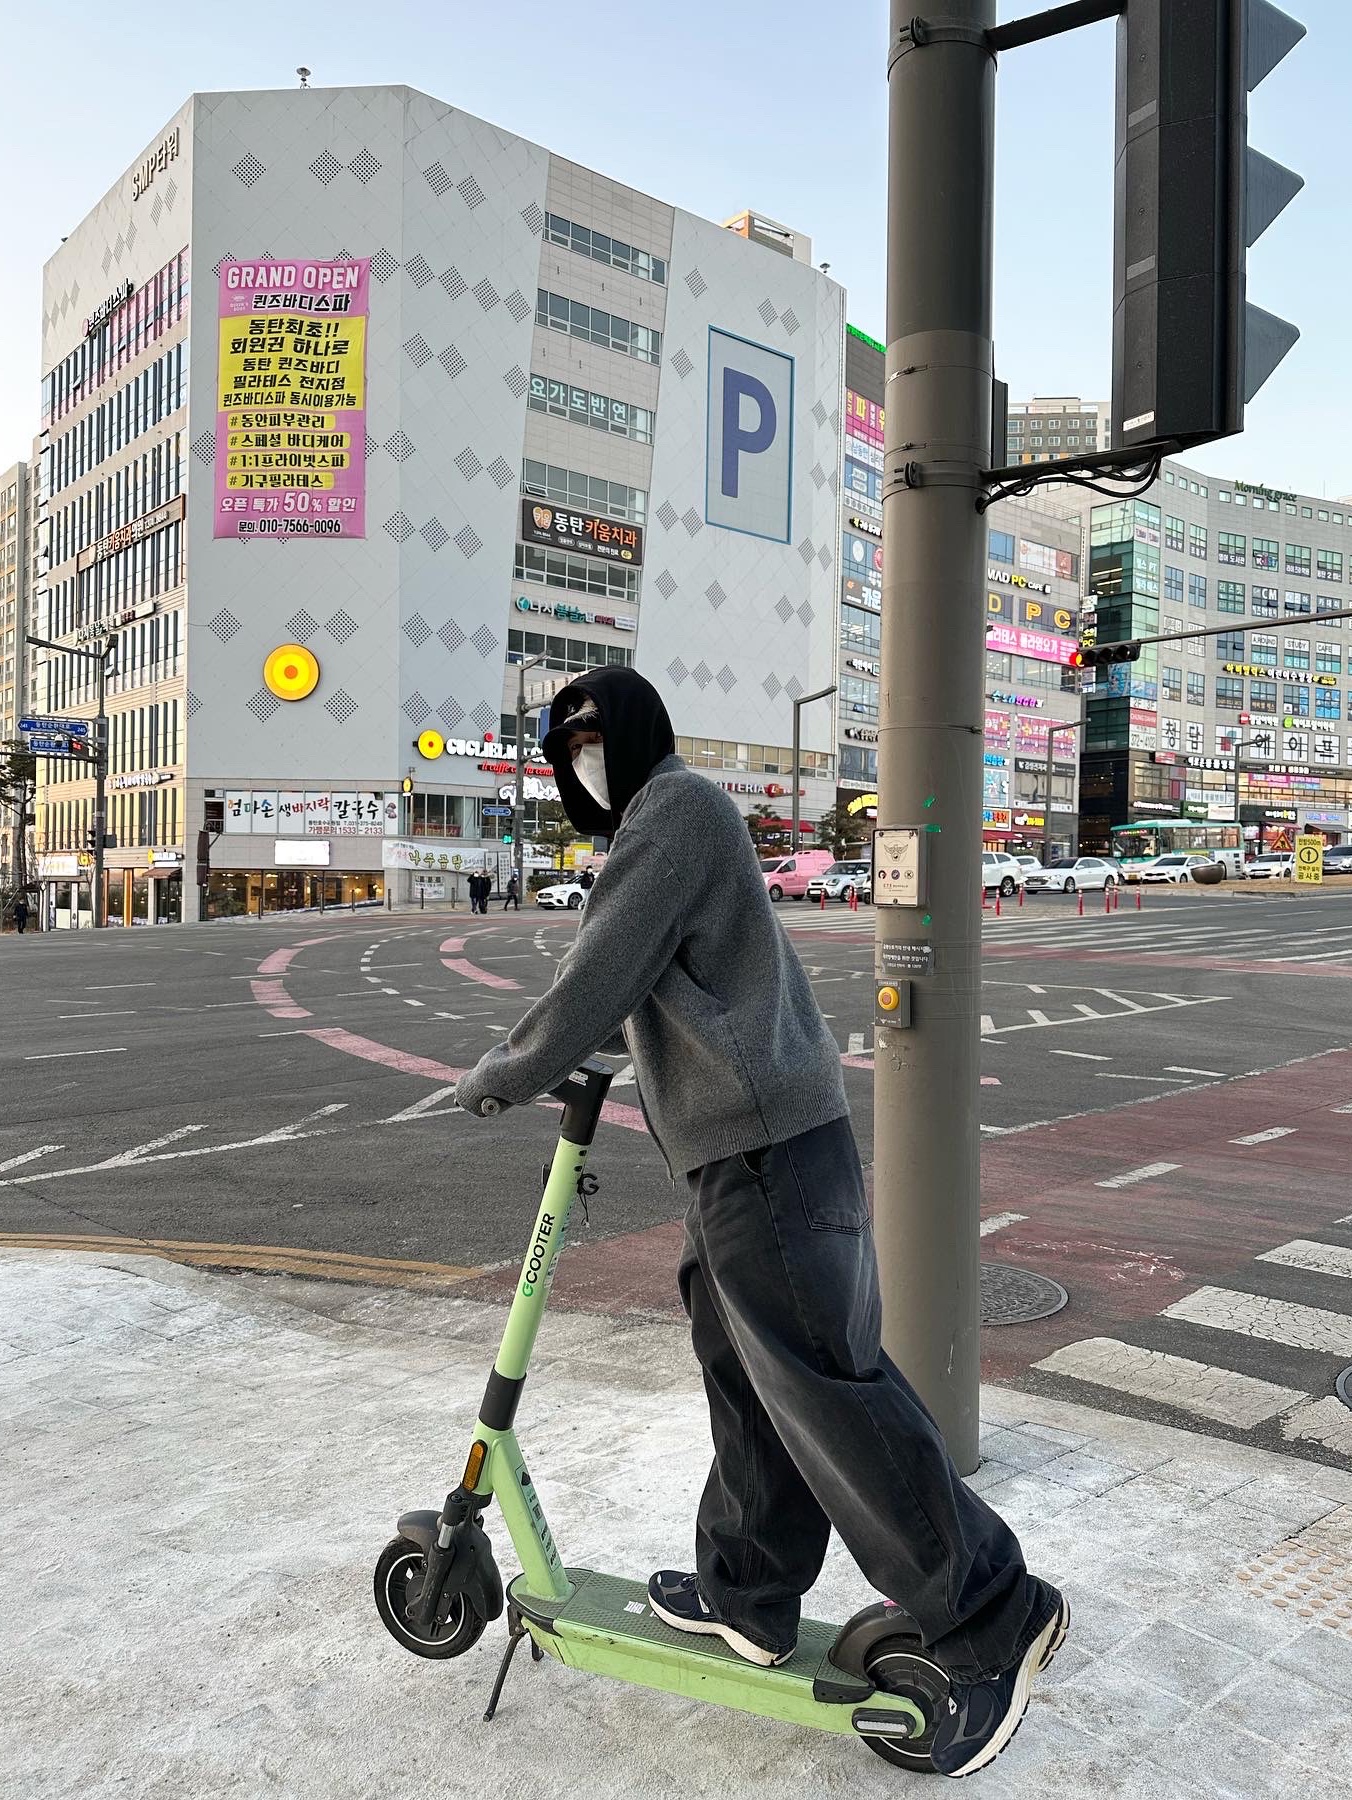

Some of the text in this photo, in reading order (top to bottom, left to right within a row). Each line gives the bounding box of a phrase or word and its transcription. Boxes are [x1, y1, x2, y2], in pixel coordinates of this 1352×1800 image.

[131, 127, 180, 202] SMP타워
[227, 266, 360, 289] GRAND OPEN
[253, 293, 351, 312] 퀸즈바디스파
[249, 318, 340, 338] 동탄최초!!
[230, 337, 349, 356] 회원권 하나로
[243, 357, 340, 374] 동탄 퀸즈바디
[233, 374, 345, 390] 필라테스 전지점
[223, 391, 357, 407] 퀸즈바디스파 동시이용가능
[287, 433, 344, 448] 바디케어
[722, 367, 777, 499] P
[1234, 480, 1297, 502] Morning grace
[220, 491, 357, 513] 오픈 특가 50% 할인
[259, 519, 341, 534] 010-7566-0096
[554, 511, 638, 549] 동탄키움치과
[1011, 575, 1027, 588] PC
[1262, 589, 1278, 601] CM
[1287, 640, 1306, 650] STUDY
[1318, 645, 1333, 653] CAFE
[714, 781, 767, 794] OTTERIA
[228, 797, 379, 820] 엄마손 생바지락 칼국수
[308, 826, 337, 835] 가맹문의
[409, 850, 463, 870] 나주곰탕
[522, 1212, 556, 1298] GCOOTER
